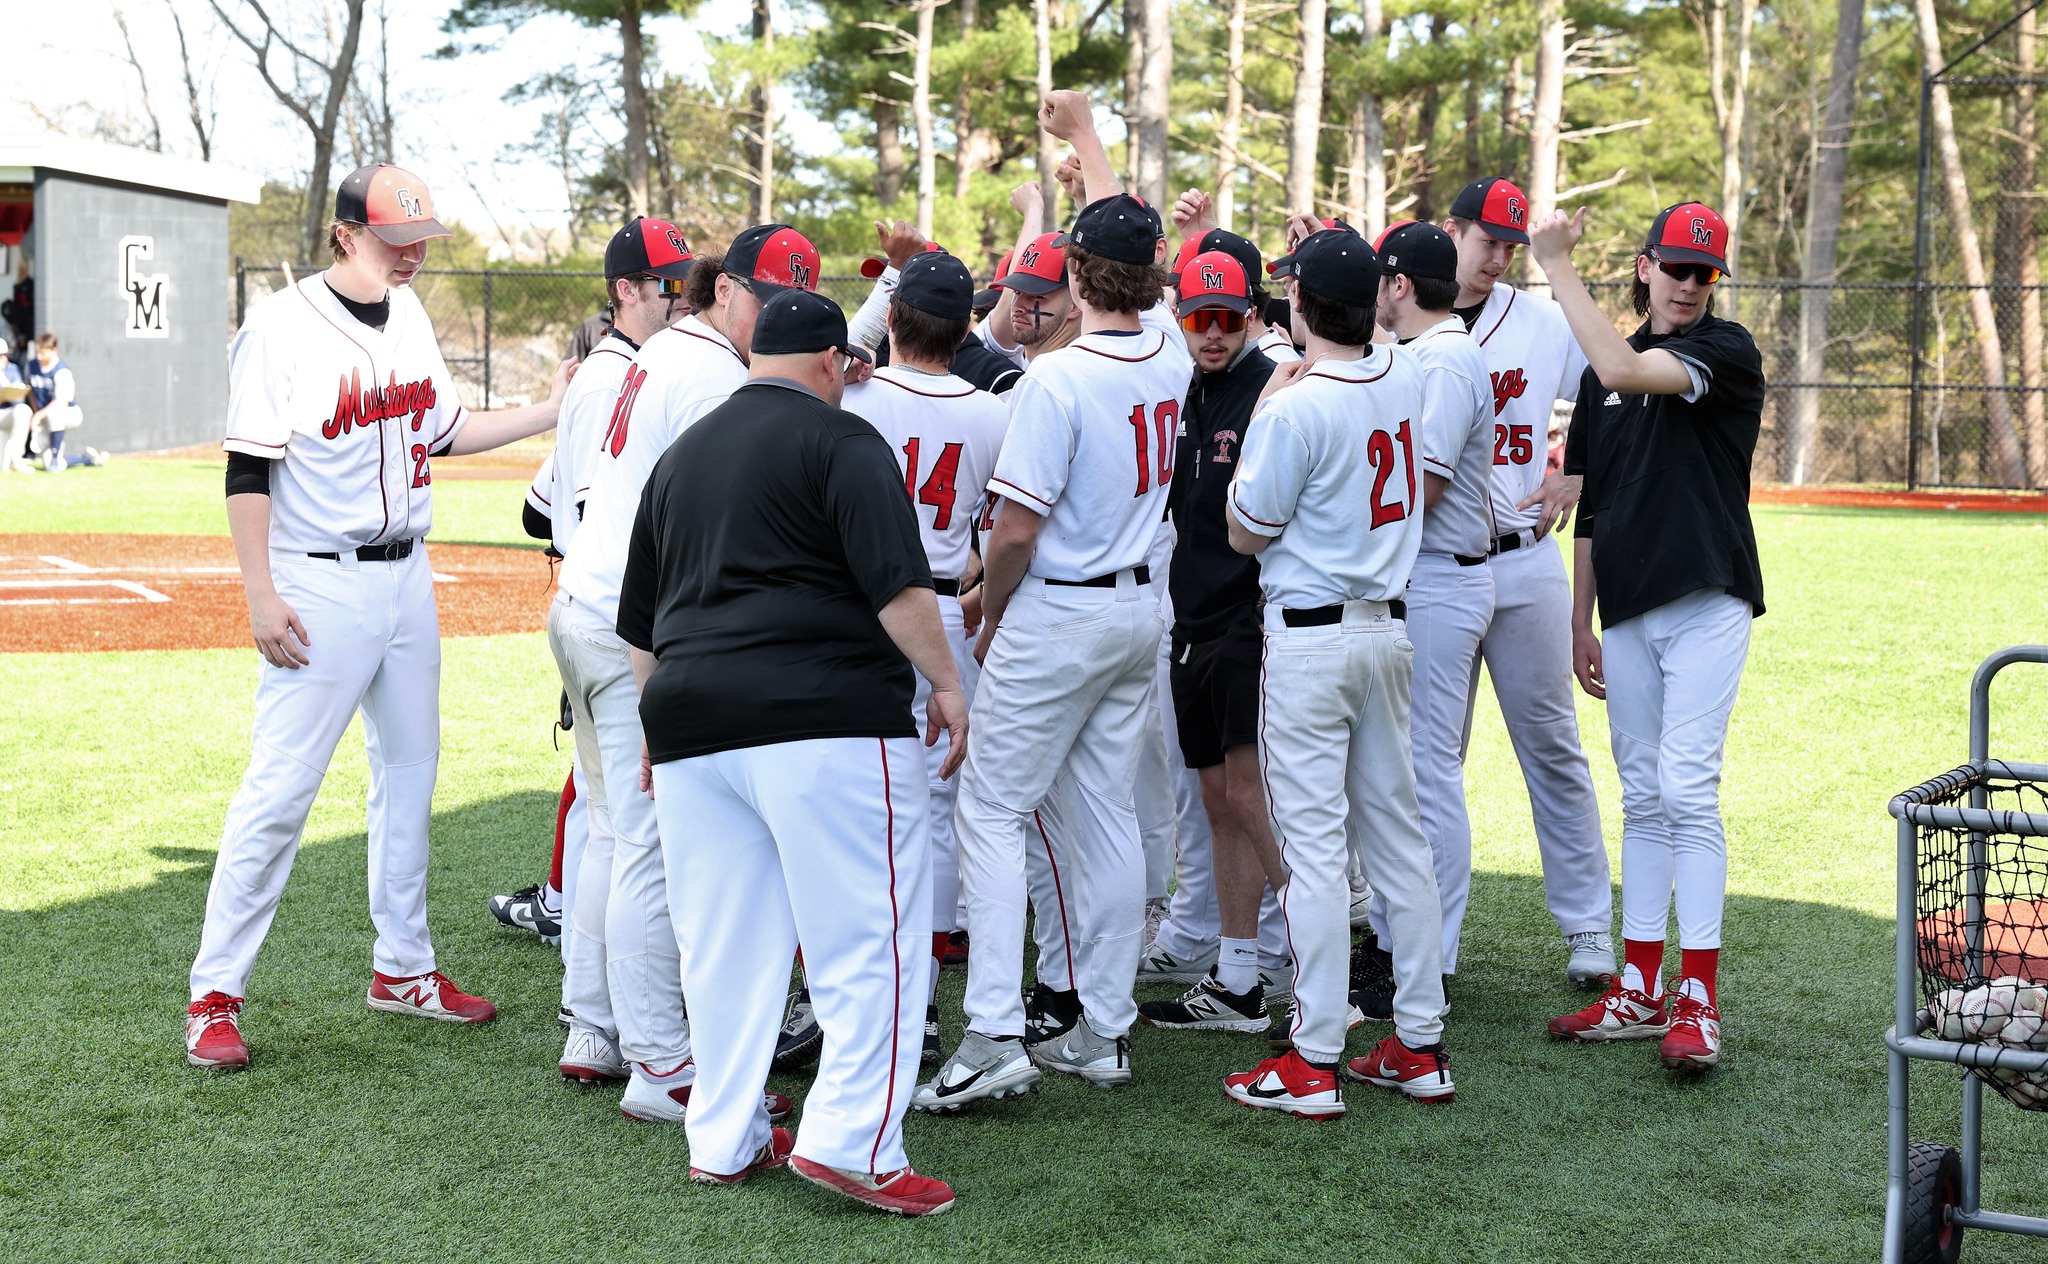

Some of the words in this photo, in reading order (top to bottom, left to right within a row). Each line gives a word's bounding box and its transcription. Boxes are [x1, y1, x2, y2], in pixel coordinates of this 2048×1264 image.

[397, 187, 423, 218] CM
[1507, 197, 1524, 226] CM
[1690, 218, 1714, 247] CM
[789, 253, 811, 287] CM
[1020, 243, 1041, 269] CM
[1201, 264, 1224, 290] CM
[322, 366, 436, 440] Mustangs
[1127, 398, 1180, 499] 10
[1492, 423, 1534, 466] 25
[902, 436, 965, 531] 14
[1366, 417, 1417, 531] 21
